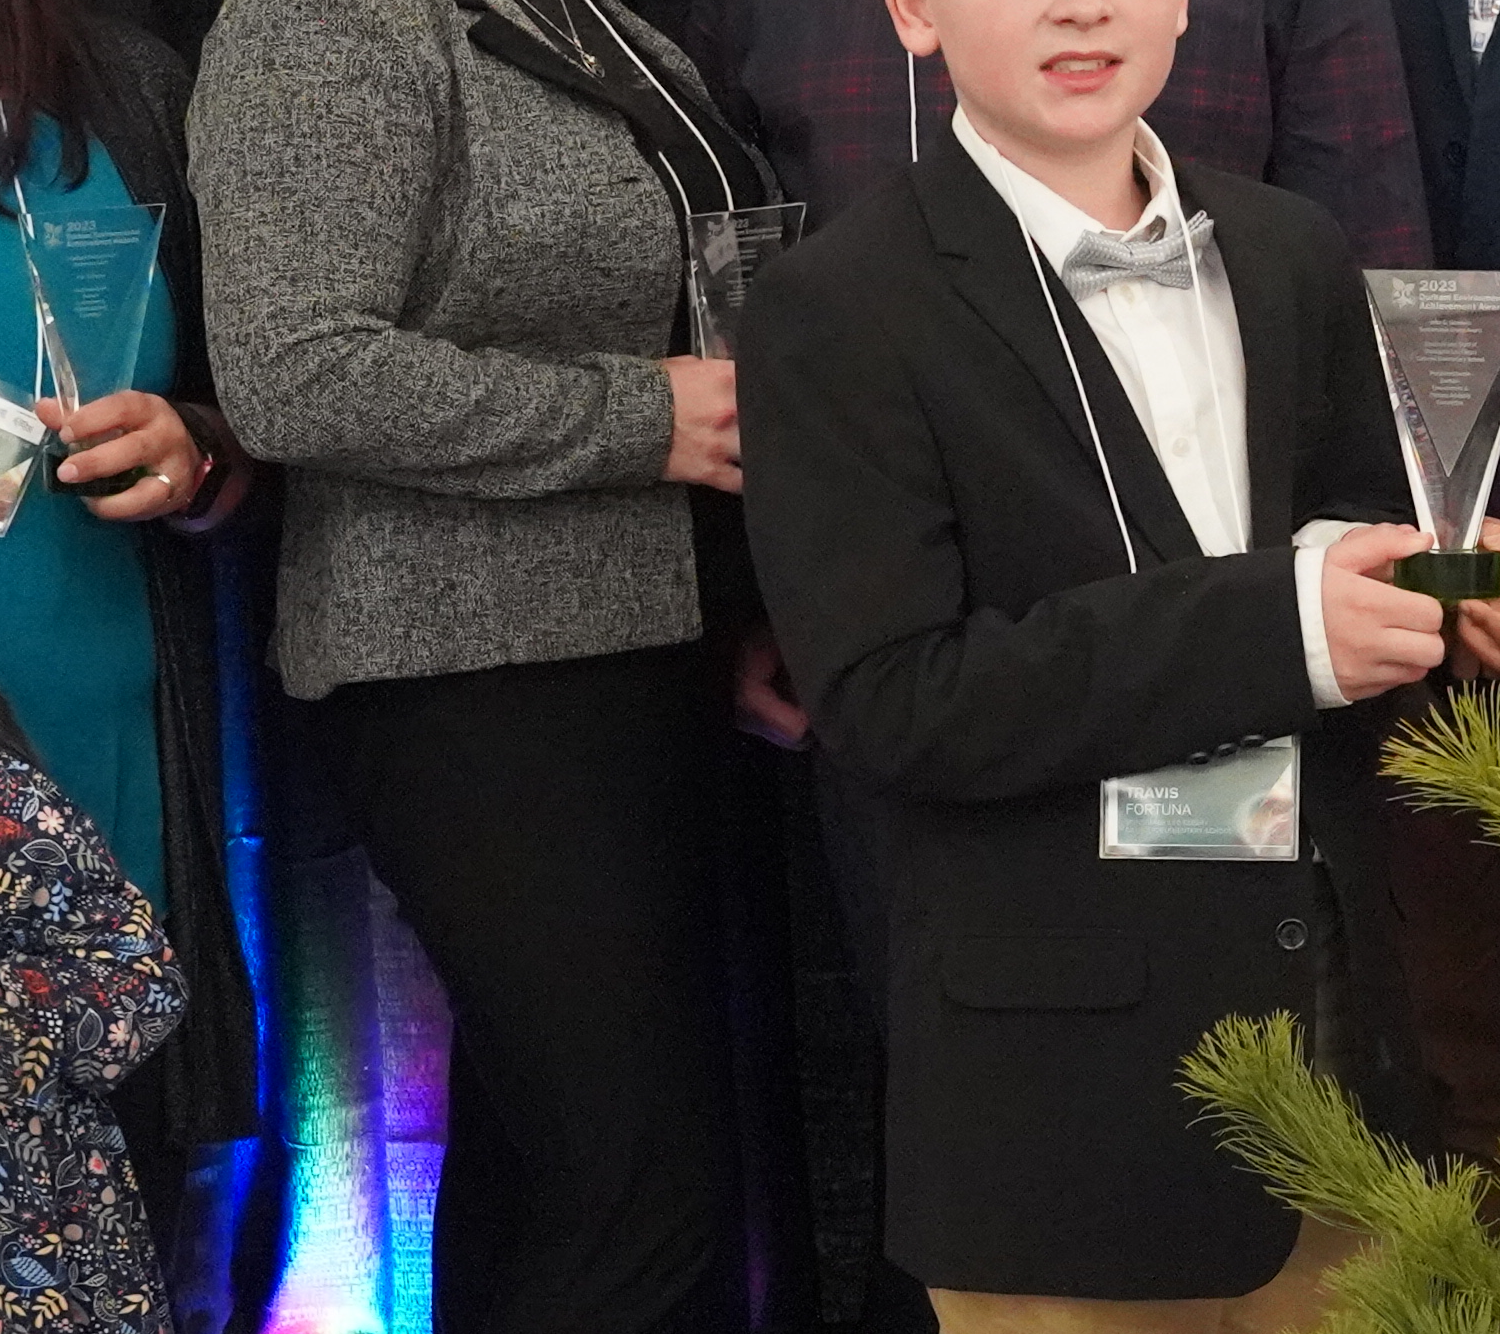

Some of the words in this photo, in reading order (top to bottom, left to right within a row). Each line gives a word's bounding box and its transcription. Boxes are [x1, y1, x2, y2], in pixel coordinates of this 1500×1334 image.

[1418, 279, 1457, 292] 2023
[1127, 787, 1179, 799] TRAVIS
[1125, 803, 1192, 816] FORTUNA
